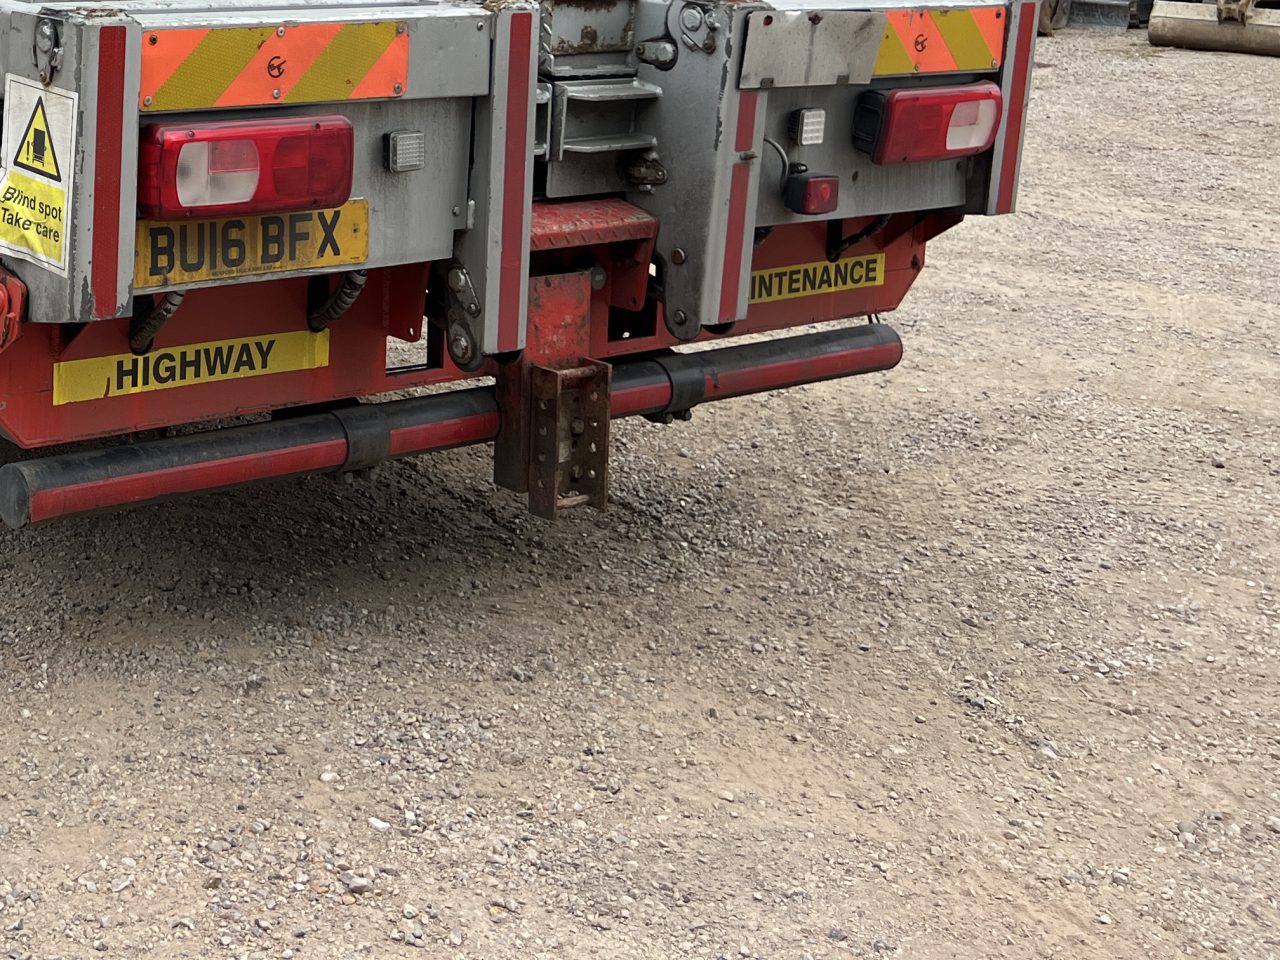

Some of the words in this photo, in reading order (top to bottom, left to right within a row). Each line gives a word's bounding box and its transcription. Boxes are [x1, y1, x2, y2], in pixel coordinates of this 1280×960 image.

[1, 206, 32, 231] Take
[36, 223, 60, 243] care
[2, 186, 37, 211] Blind
[38, 201, 62, 222] spot
[149, 220, 246, 277] BU16
[260, 210, 341, 265] BFX
[749, 259, 878, 300] INTENANCE
[115, 339, 276, 390] HIGHWAY
